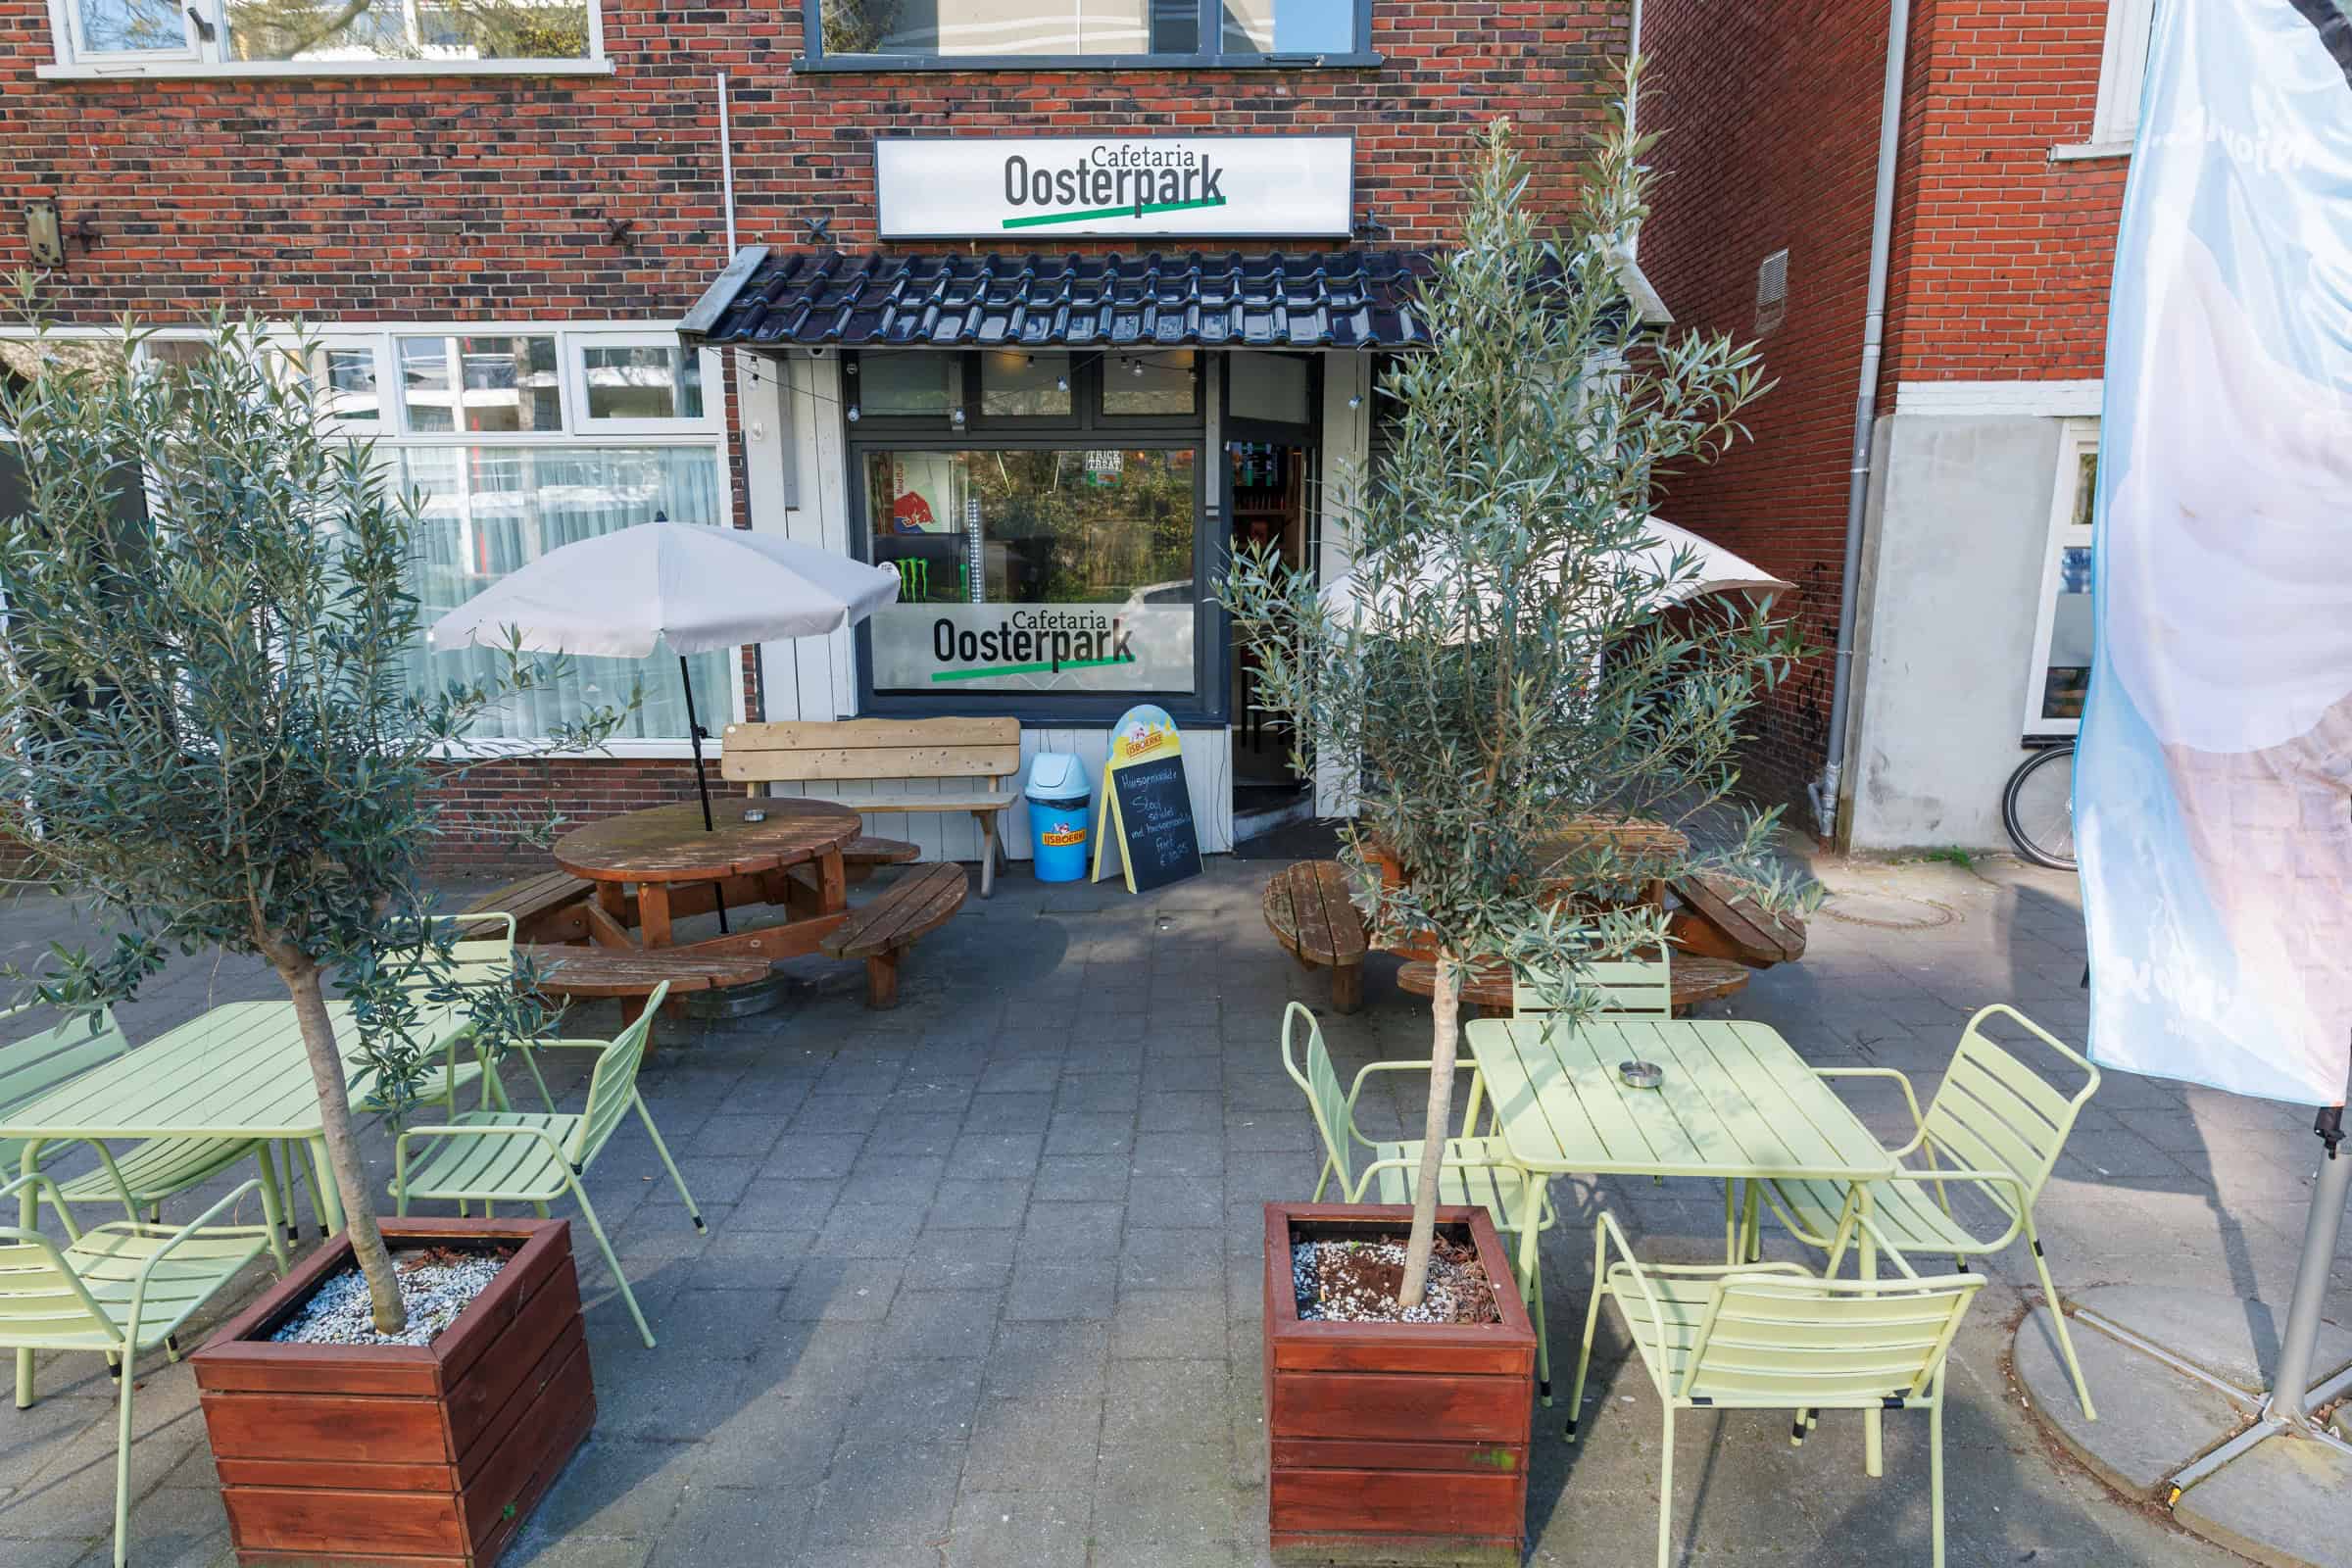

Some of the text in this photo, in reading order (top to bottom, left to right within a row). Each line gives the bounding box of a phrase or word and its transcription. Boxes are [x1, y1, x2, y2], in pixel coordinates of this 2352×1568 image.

[1091, 144, 1196, 168] Cafetaria
[1004, 154, 1224, 219] Oosterpark
[1012, 610, 1107, 630] Cafetaria
[933, 617, 1135, 673] Oosterpark
